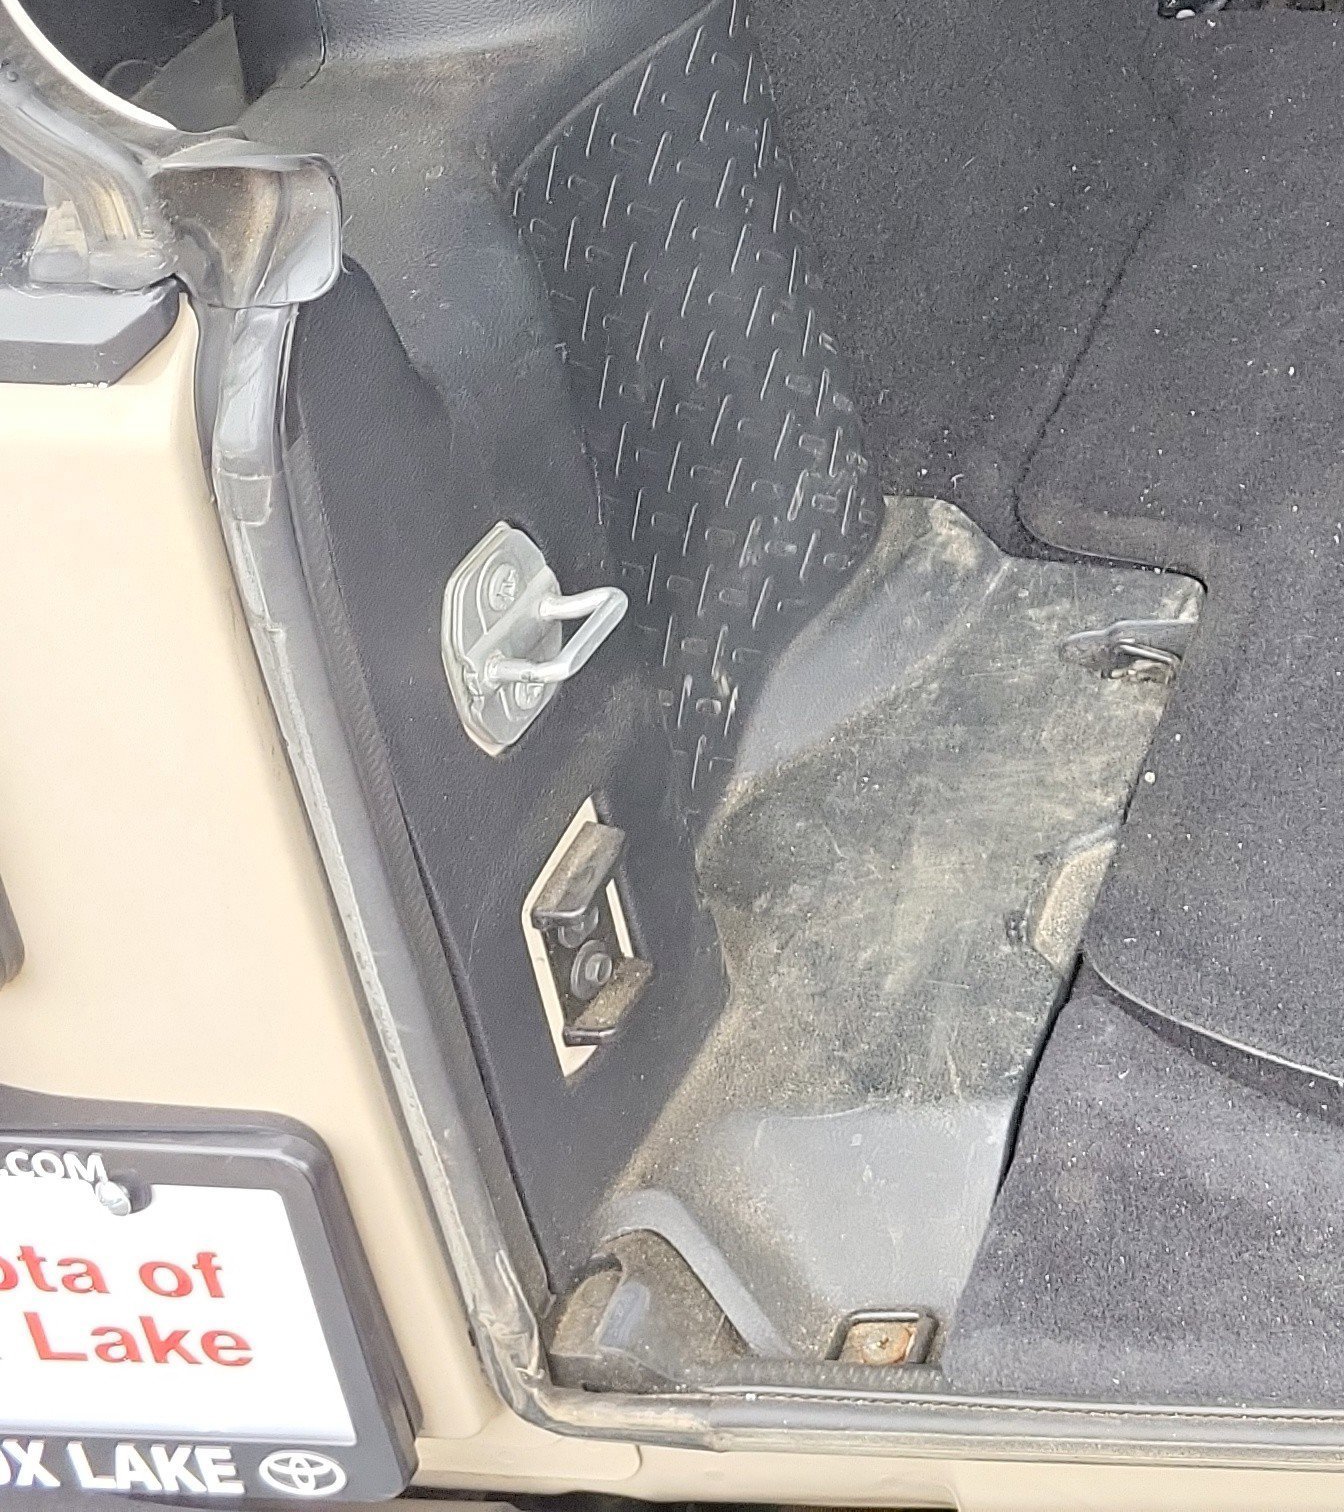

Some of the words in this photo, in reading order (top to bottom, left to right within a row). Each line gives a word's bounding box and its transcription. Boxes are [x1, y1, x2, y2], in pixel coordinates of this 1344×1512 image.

[138, 1251, 225, 1298] of
[24, 1311, 253, 1367] Lake
[66, 1440, 245, 1494] LAKE
